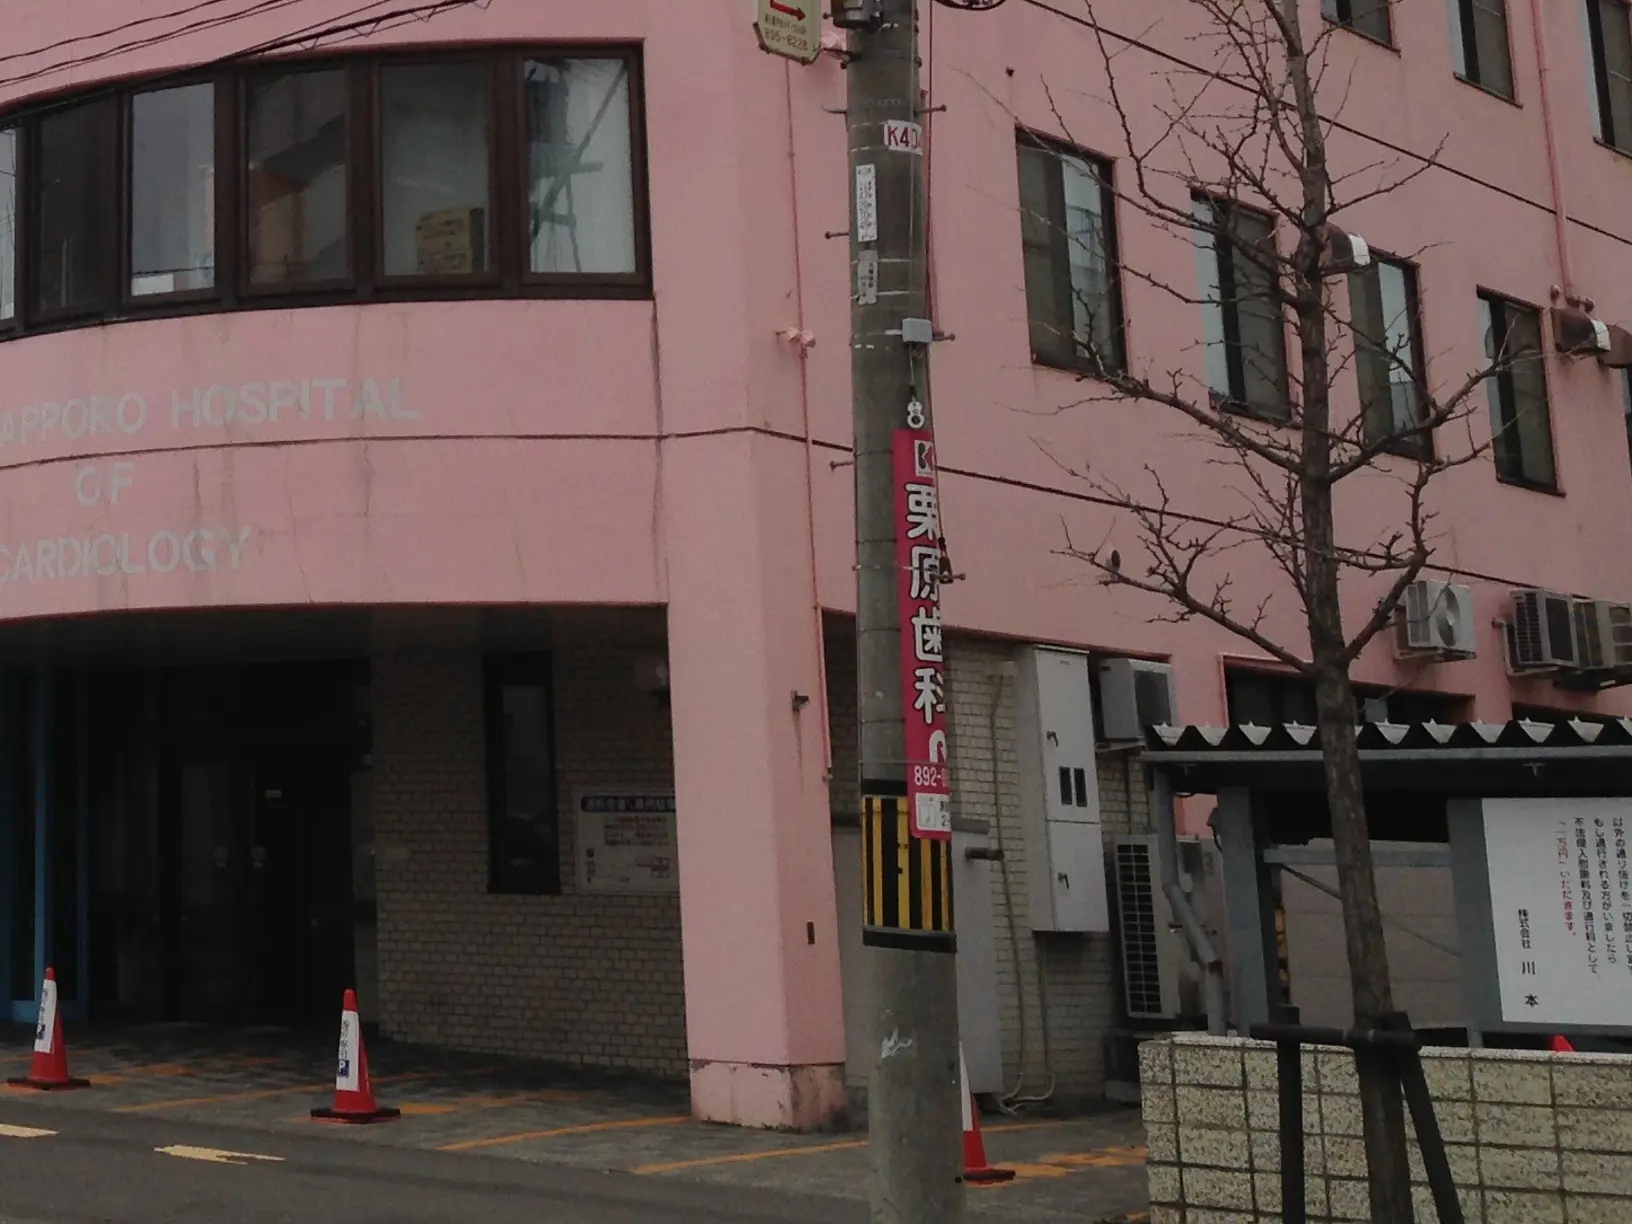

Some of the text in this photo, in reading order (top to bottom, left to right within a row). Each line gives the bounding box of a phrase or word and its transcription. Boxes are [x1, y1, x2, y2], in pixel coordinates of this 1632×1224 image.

[170, 376, 424, 430] HOSPITAL
[74, 461, 138, 508] OF
[1517, 908, 1532, 950] 株式会社
